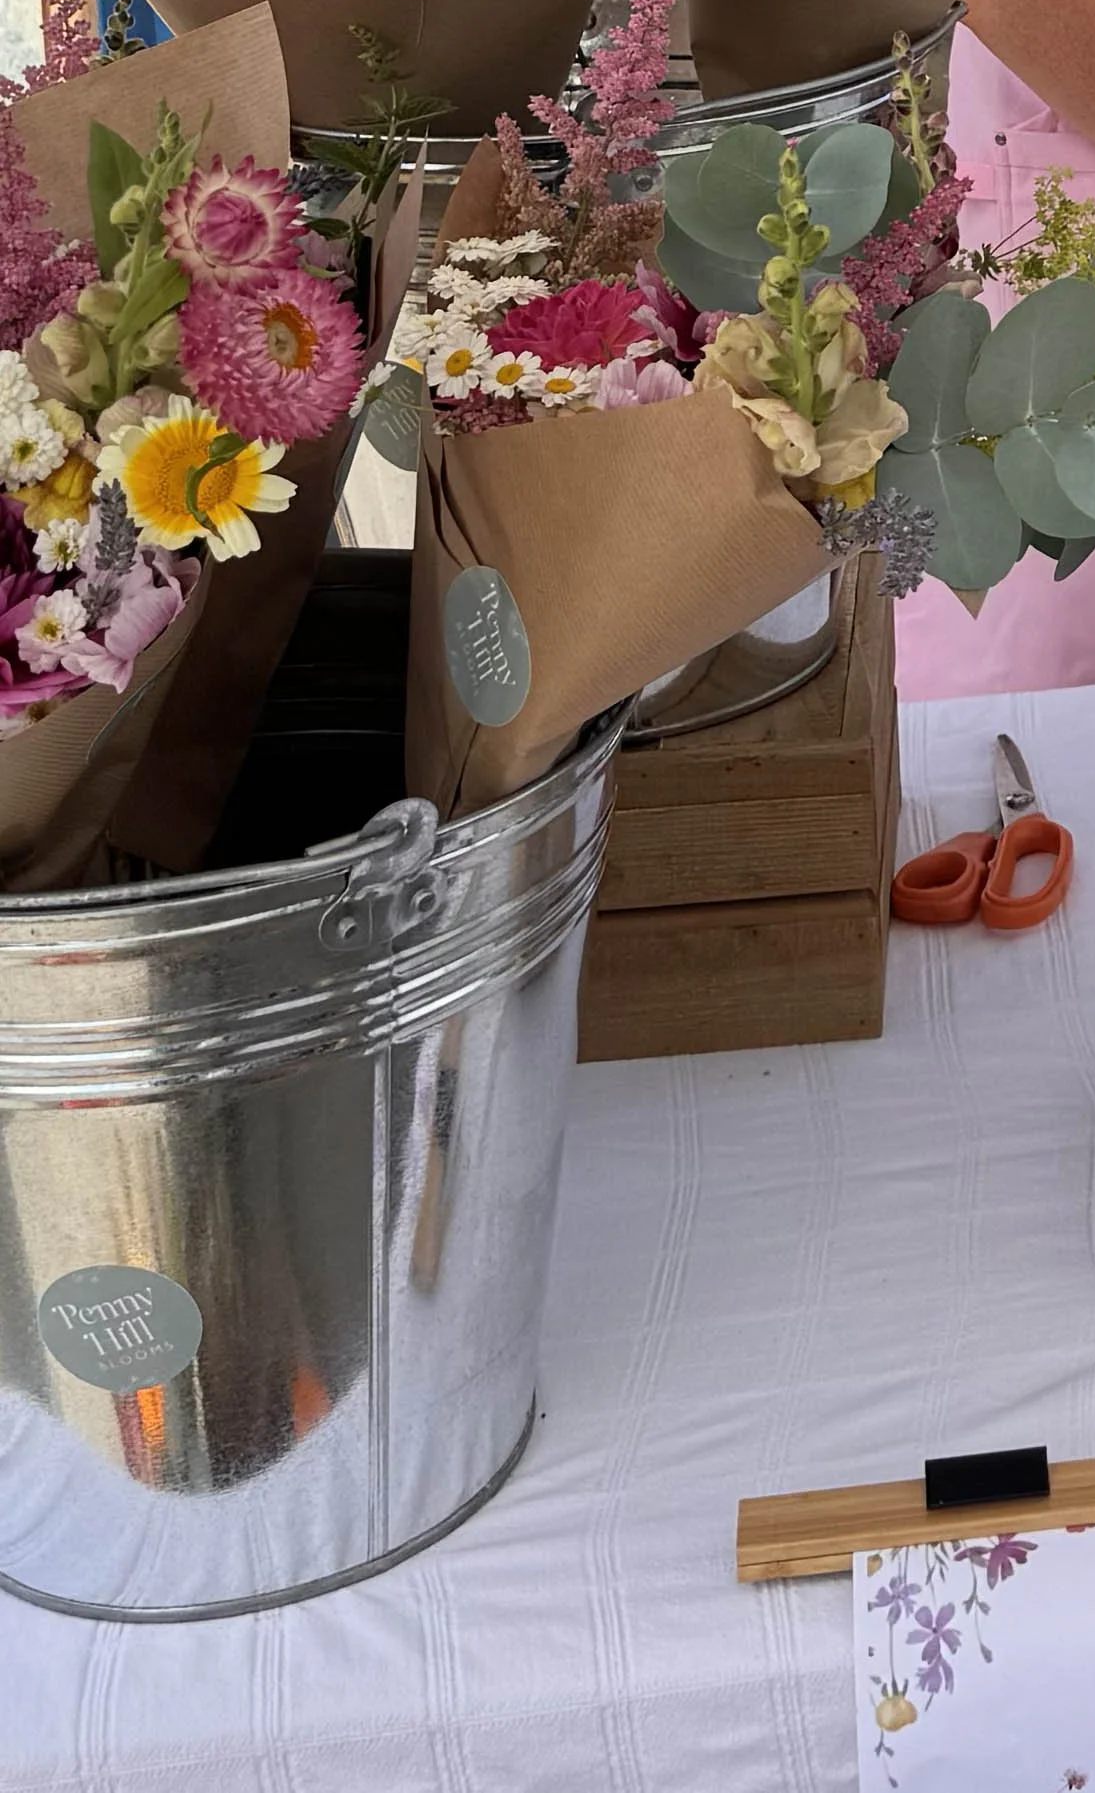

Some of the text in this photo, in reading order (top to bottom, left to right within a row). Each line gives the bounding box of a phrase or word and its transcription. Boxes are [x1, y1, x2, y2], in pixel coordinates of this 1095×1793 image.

[467, 610, 495, 681] Hill
[480, 582, 518, 687] Penny
[51, 1287, 154, 1330] Penny
[82, 1315, 155, 1356] Hill
